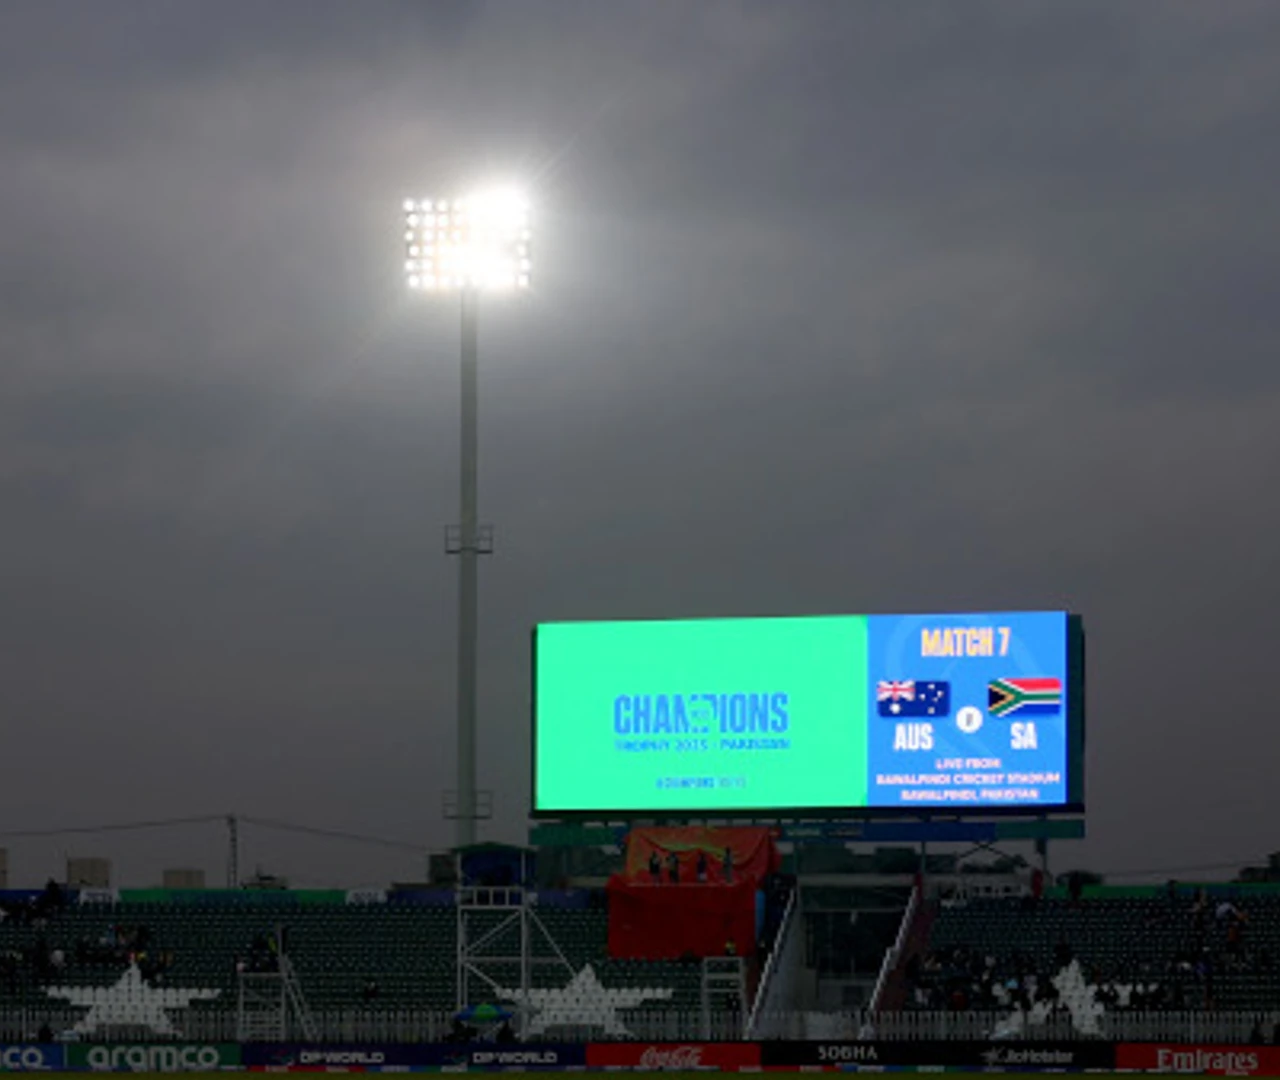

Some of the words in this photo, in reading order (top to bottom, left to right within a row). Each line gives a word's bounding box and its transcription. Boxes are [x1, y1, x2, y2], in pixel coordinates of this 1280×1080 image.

[921, 628, 993, 657] MATCH
[998, 627, 1010, 656] 7
[893, 724, 935, 751] AUS
[1010, 722, 1037, 749] SA
[935, 758, 961, 769] LIVE
[87, 1045, 219, 1071] aramco
[300, 1051, 323, 1064] DP
[323, 1051, 385, 1064] WORLD
[472, 1051, 496, 1064] DP
[496, 1051, 558, 1064] WORLD
[818, 1045, 878, 1060] SOBHA
[1005, 1048, 1074, 1063] JioHotstar
[1157, 1049, 1259, 1071] Emirates
